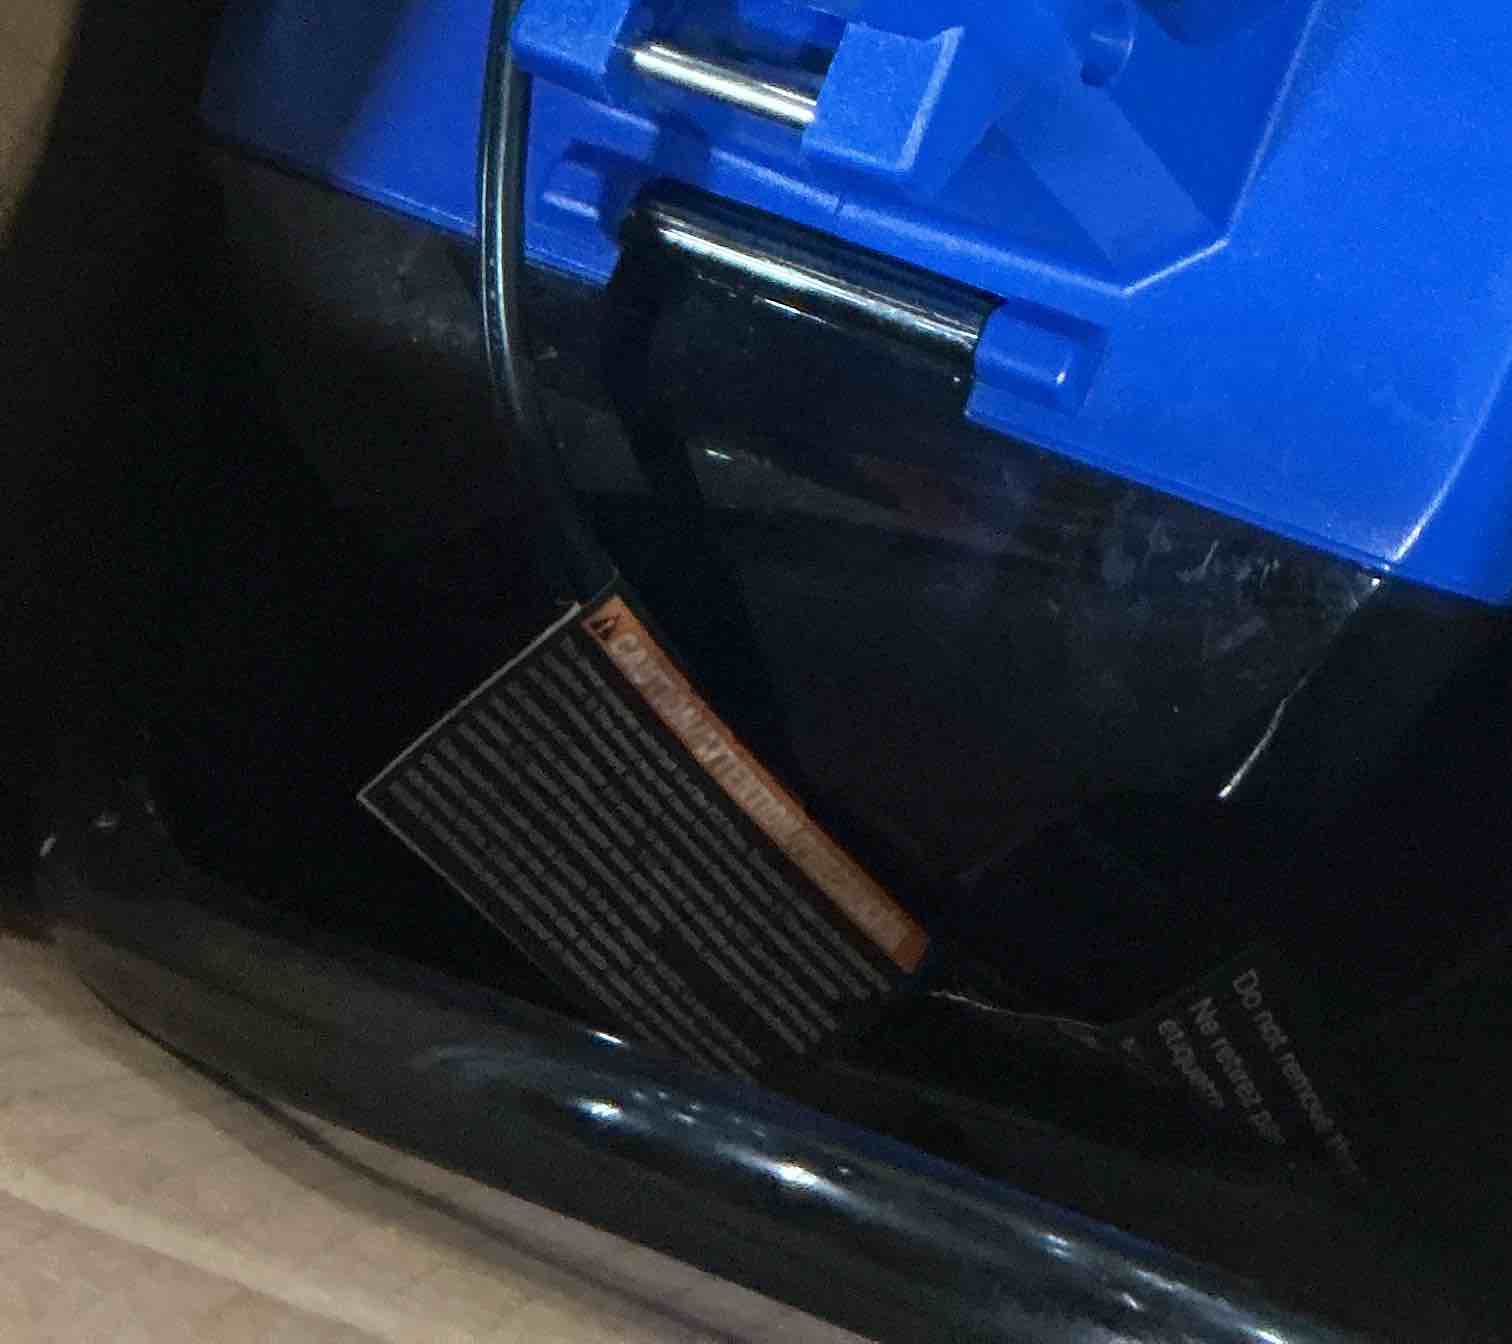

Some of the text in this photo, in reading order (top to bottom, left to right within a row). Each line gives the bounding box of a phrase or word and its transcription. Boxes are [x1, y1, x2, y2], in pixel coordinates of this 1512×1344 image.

[1190, 997, 1220, 1035] Ne
[1232, 968, 1263, 1009] Do
[1255, 1010, 1289, 1052] not
[1279, 1052, 1335, 1134] remove
